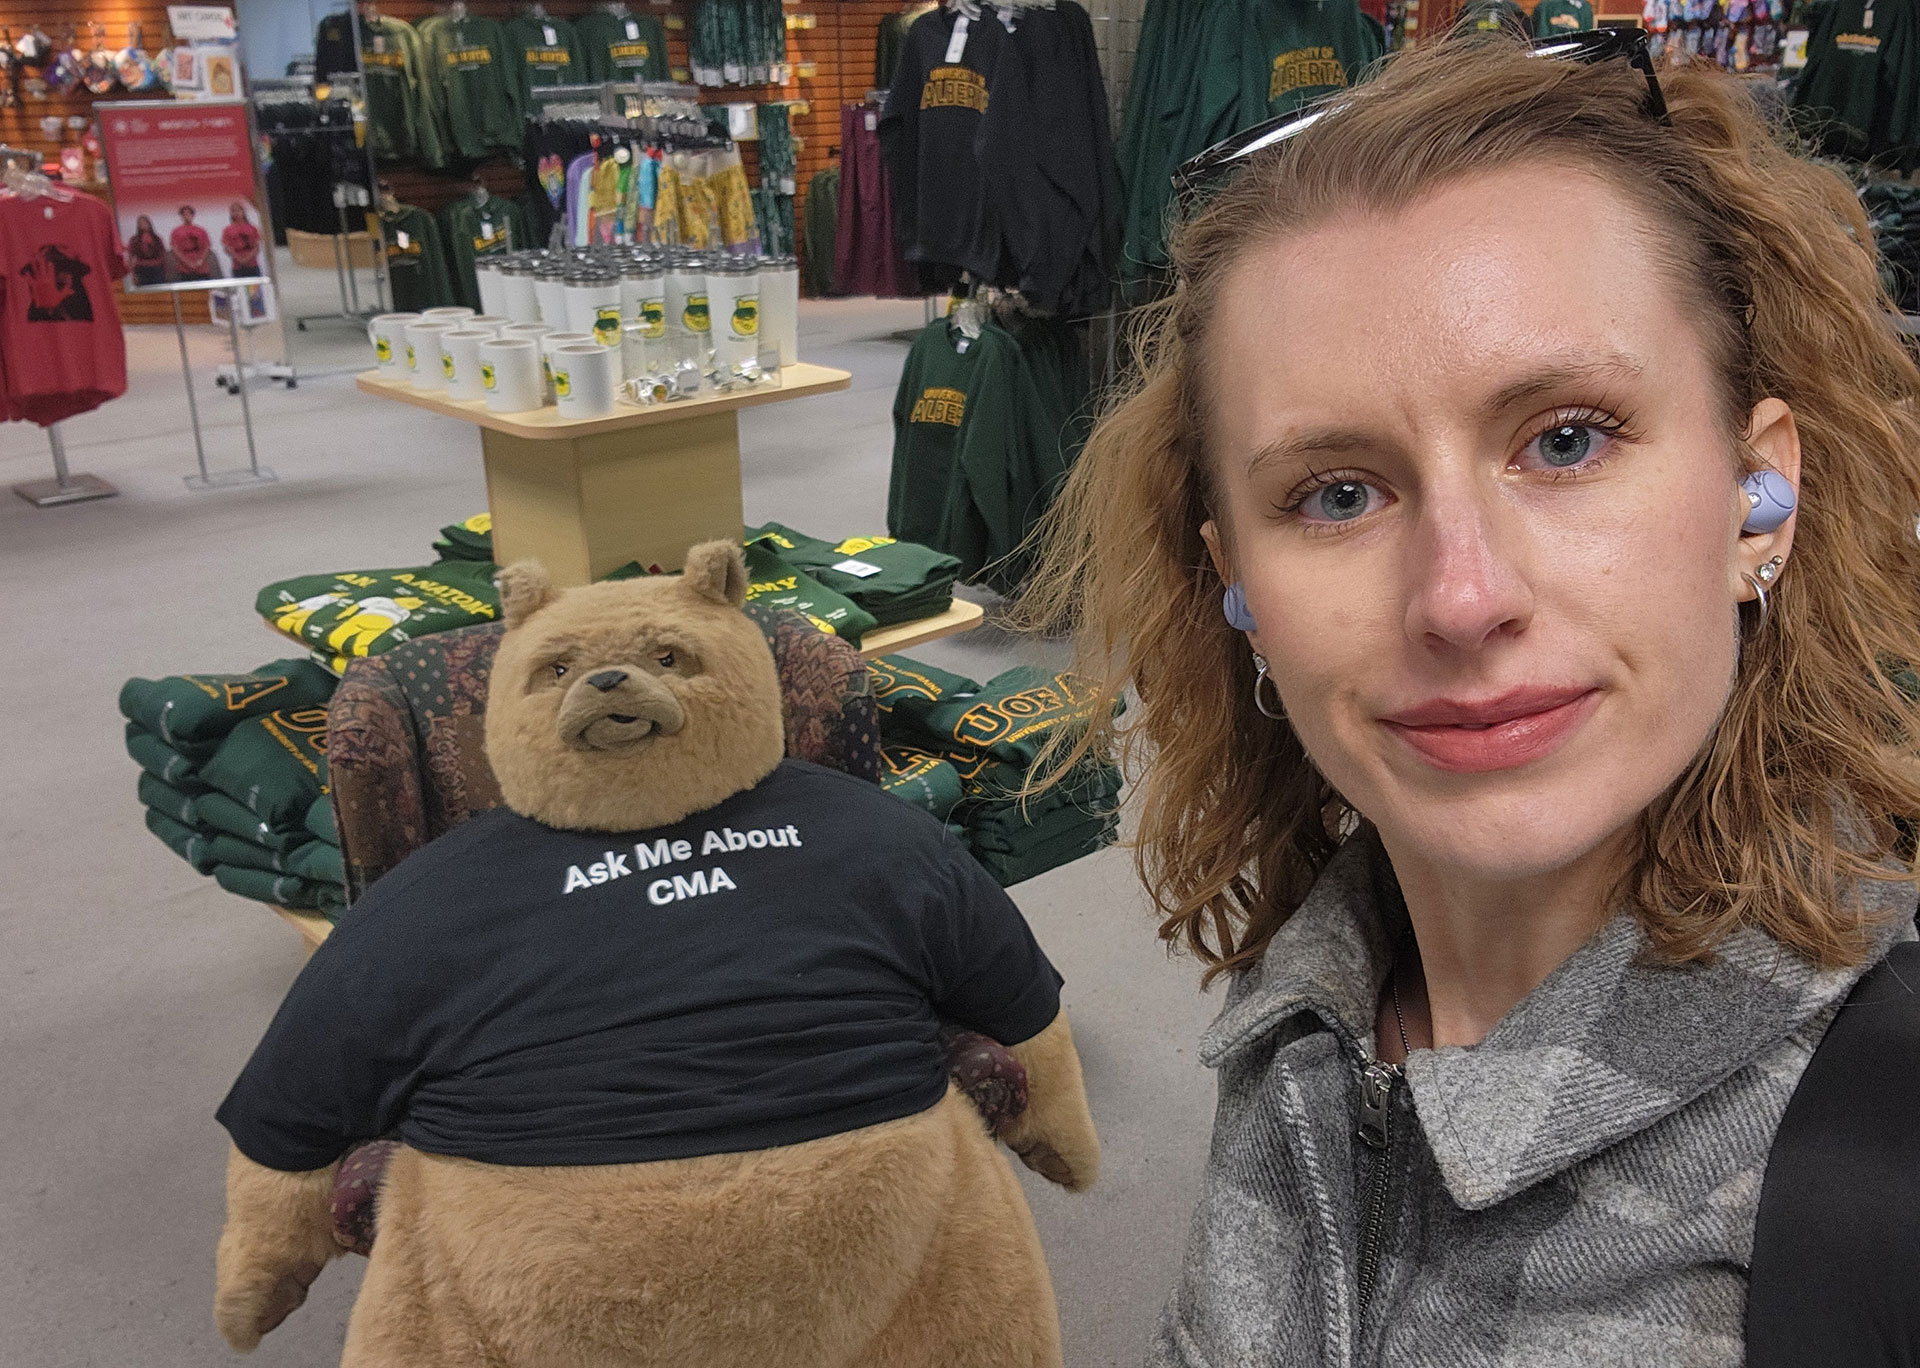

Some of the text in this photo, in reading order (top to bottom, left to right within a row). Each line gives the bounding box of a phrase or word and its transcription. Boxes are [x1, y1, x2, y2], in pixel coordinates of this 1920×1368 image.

[562, 824, 803, 895] Ask Me About
[647, 866, 738, 906] CMA
